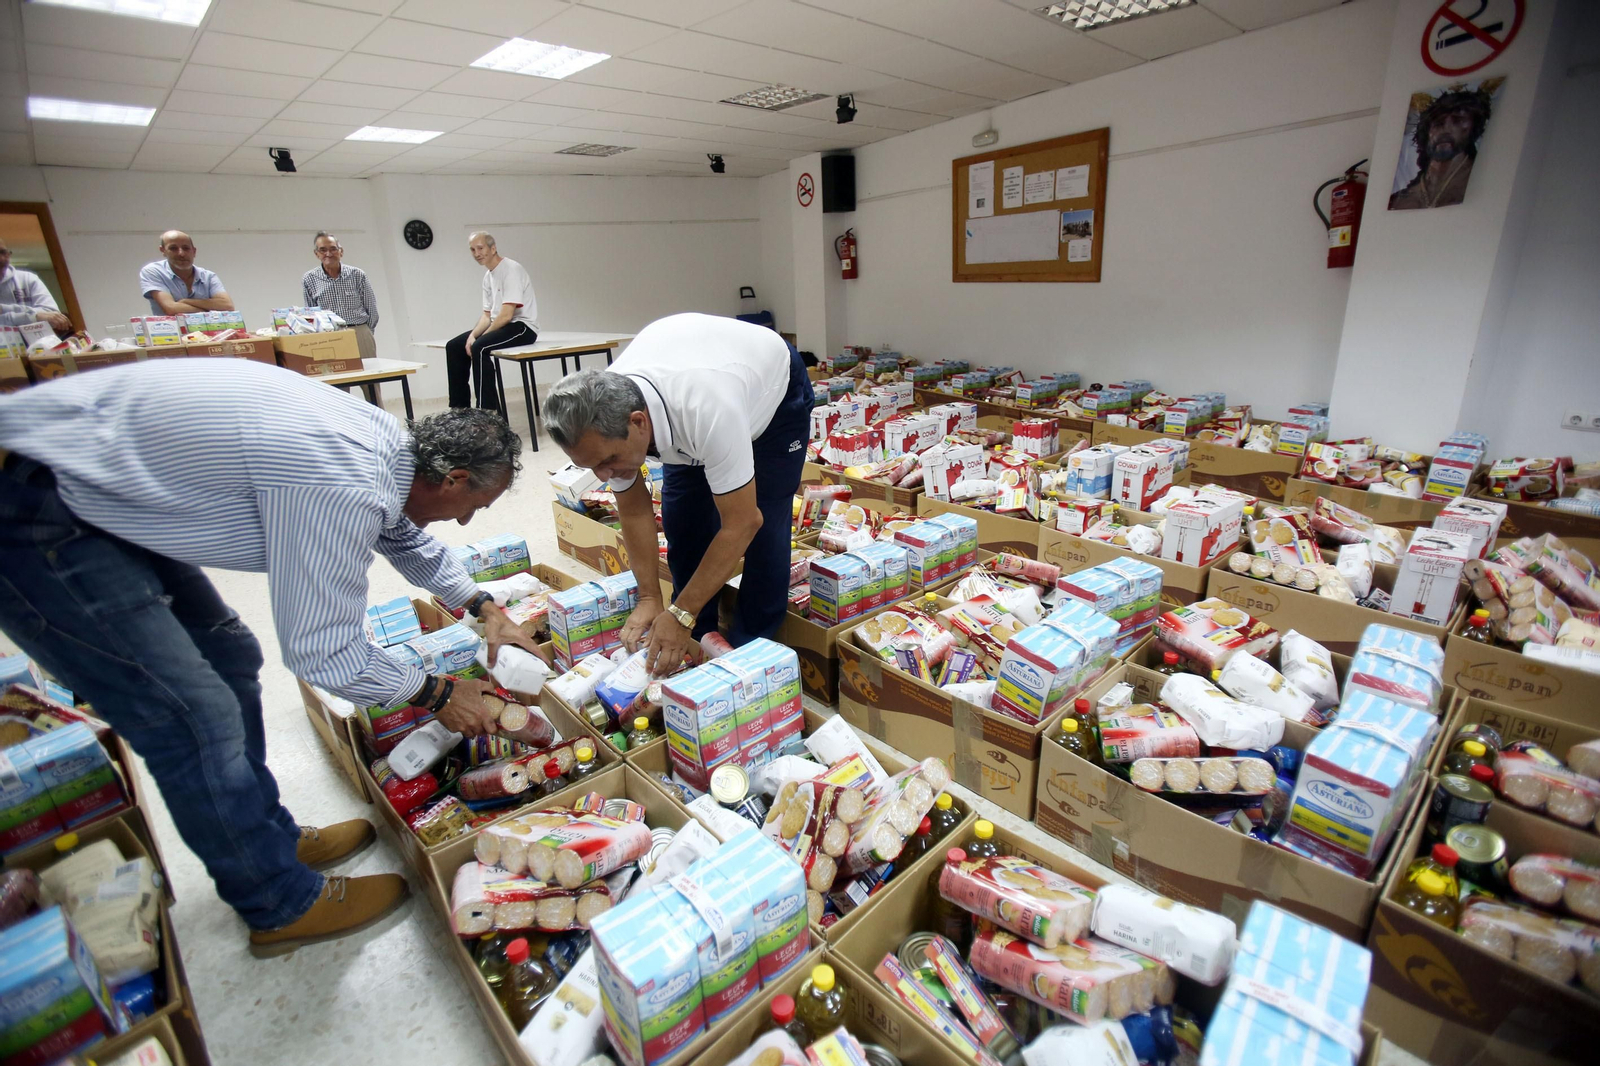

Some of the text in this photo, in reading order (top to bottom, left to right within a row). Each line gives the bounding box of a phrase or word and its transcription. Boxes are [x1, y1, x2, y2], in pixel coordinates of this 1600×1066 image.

[921, 429, 937, 438] COVAP
[966, 459, 983, 469] COVAP
[1117, 461, 1138, 470] COVAP
[1159, 464, 1173, 476] COVAP
[1436, 471, 1464, 481] ASTURIANA
[1449, 525, 1470, 534] UHT
[1045, 542, 1087, 563] Infapan
[1416, 556, 1456, 569] Leche Entera
[1423, 564, 1446, 575] UHT
[1216, 585, 1274, 613] Infapan
[579, 638, 595, 647] LECHE
[1008, 662, 1041, 687] ASTURIANA
[779, 701, 795, 713] LECHE
[384, 711, 405, 724] LECHE
[747, 717, 764, 731] LECHE
[1517, 721, 1526, 734] C
[713, 736, 730, 750] LECHE
[1311, 783, 1367, 817] ASTURIANA
[767, 899, 797, 918] ASTURIANA
[1113, 929, 1138, 944] HARINA
[774, 940, 799, 962] LECHE
[721, 977, 749, 1001] LECHE
[867, 1004, 875, 1020] C
[662, 1018, 692, 1045] LECHE
